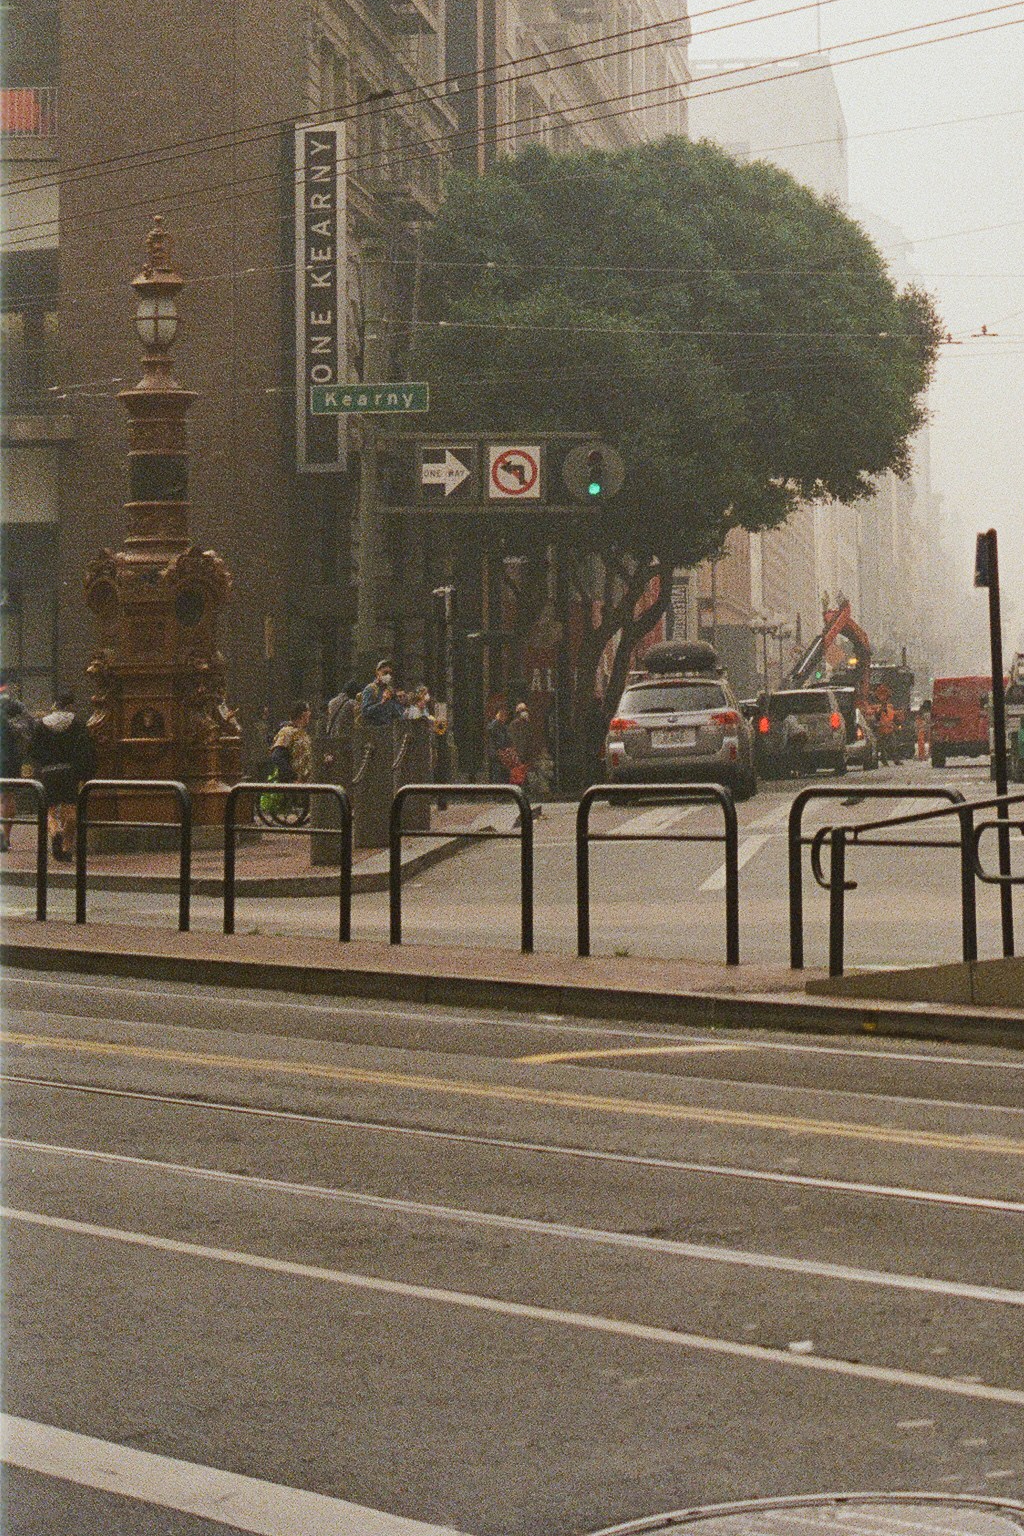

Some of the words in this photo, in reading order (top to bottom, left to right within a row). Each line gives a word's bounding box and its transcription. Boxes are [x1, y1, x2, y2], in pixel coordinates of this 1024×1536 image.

[310, 139, 332, 288] KEARNY
[310, 309, 332, 383] ONE
[324, 392, 415, 409] Kearny
[424, 468, 442, 478] ONE
